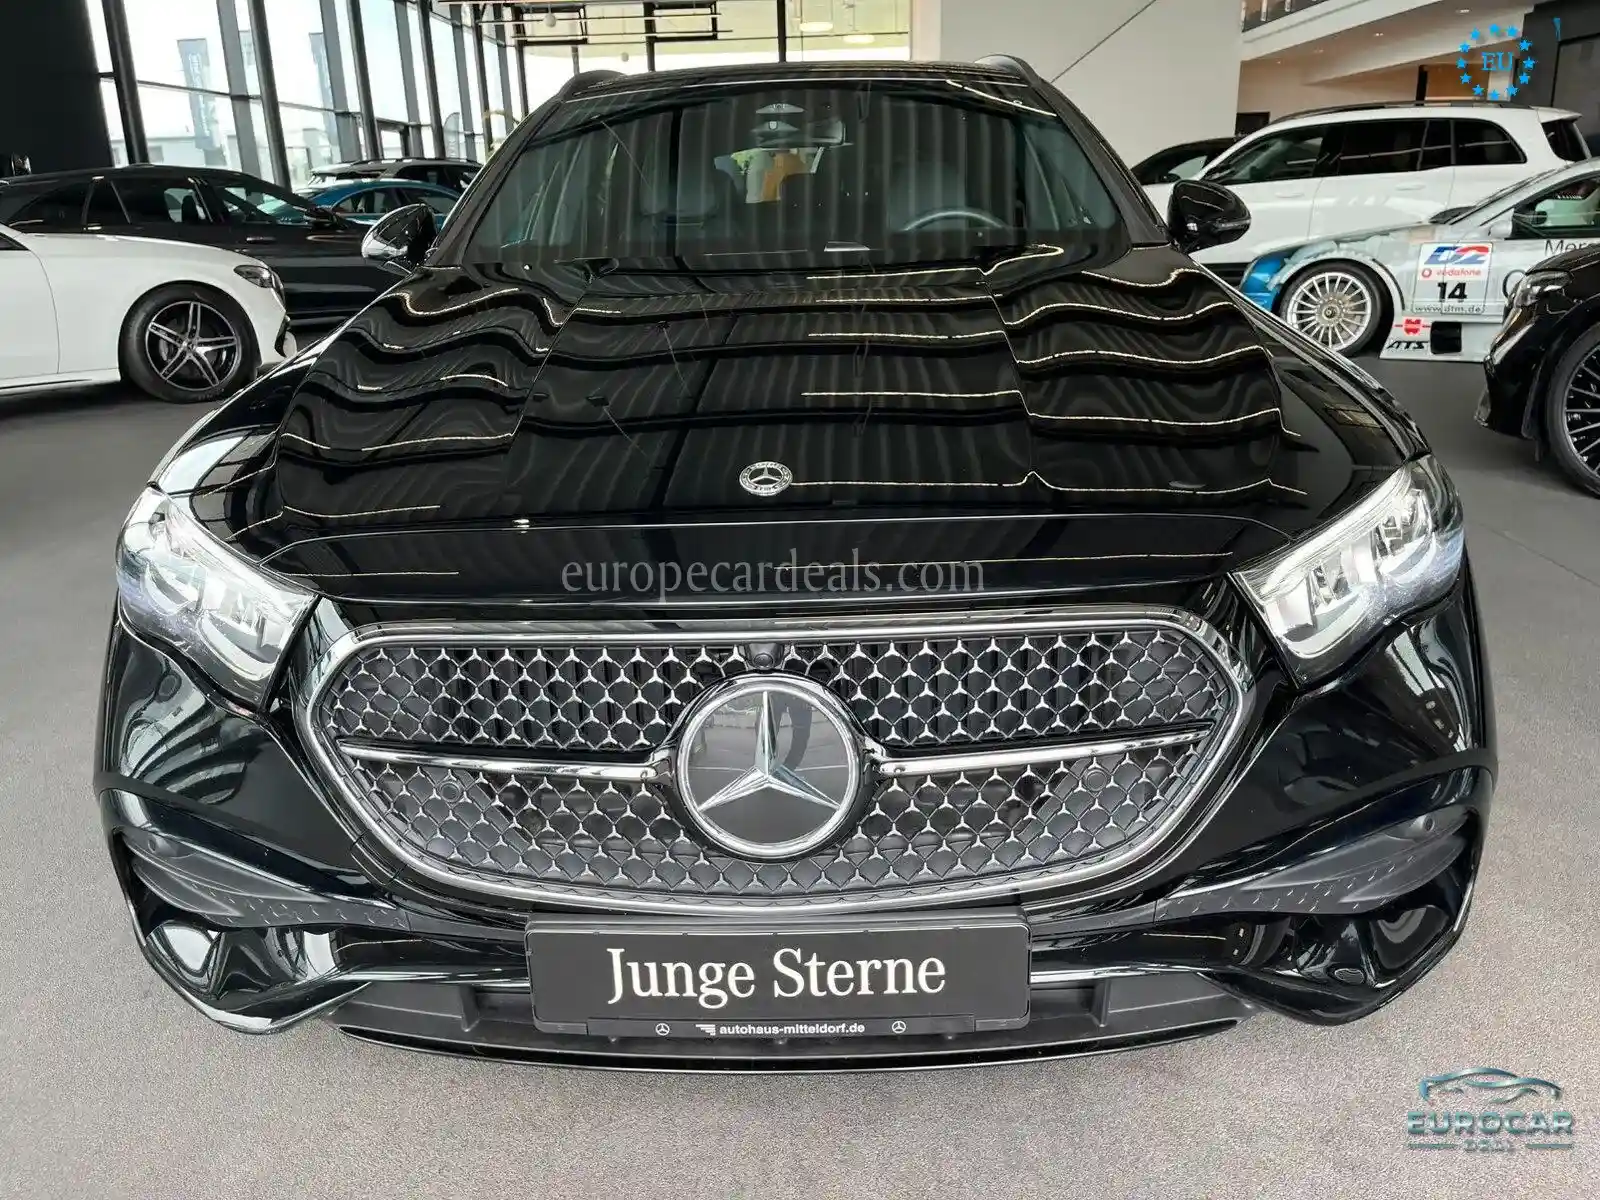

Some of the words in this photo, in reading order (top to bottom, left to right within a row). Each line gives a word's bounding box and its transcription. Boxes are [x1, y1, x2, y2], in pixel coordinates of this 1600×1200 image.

[1436, 268, 1482, 276] vodafone
[1437, 282, 1467, 302] 14
[1386, 341, 1428, 349] ATS
[607, 948, 756, 1009] Junge
[772, 947, 946, 998] Sterne
[719, 1023, 865, 1035] autohaus-mitteldorf.de
